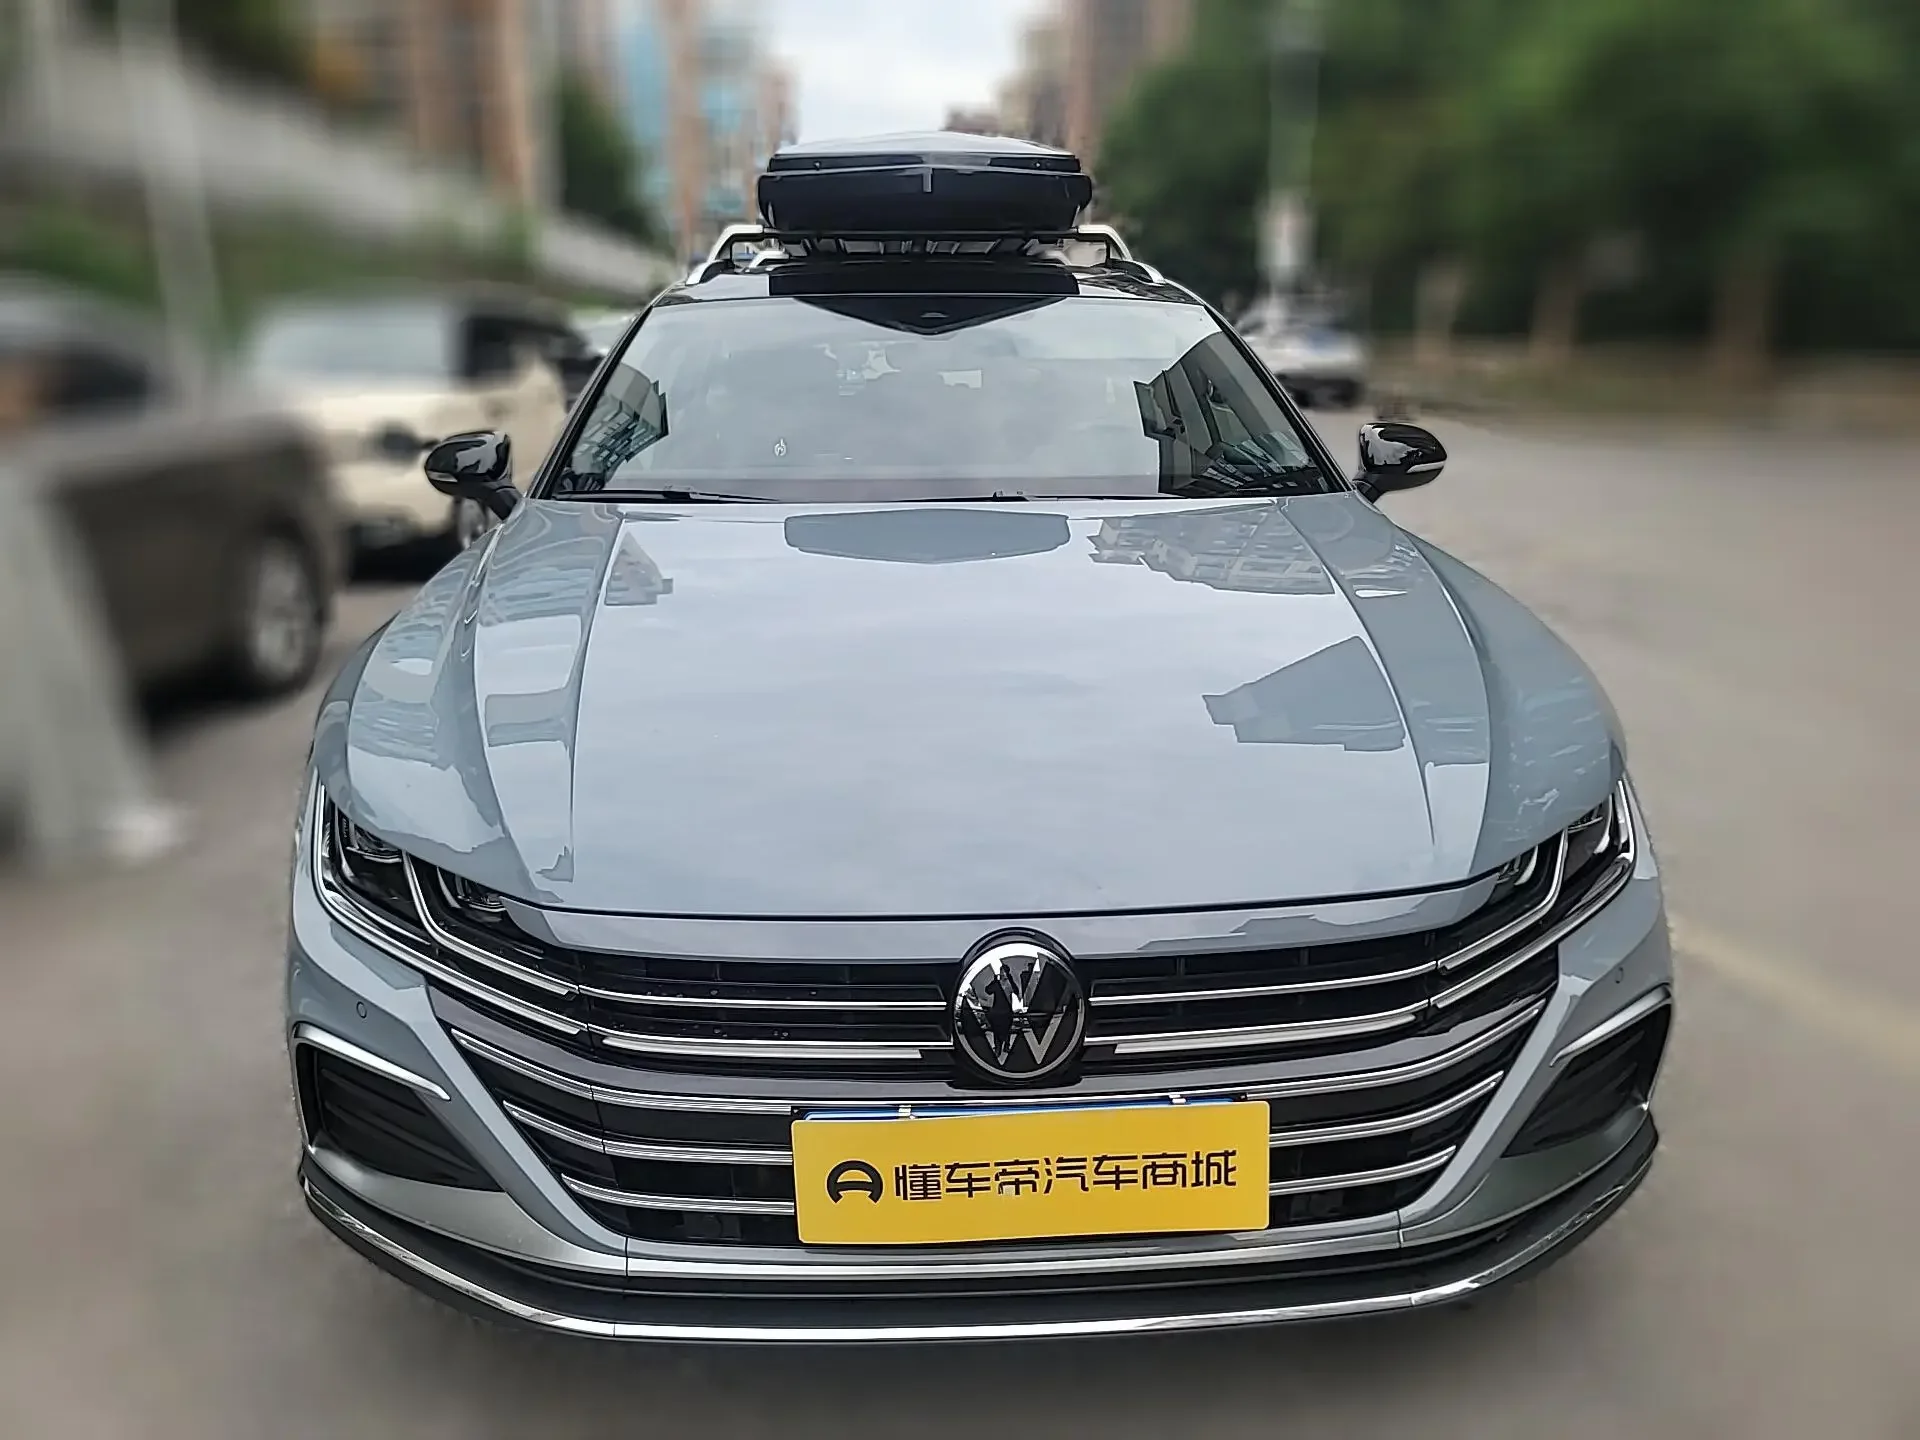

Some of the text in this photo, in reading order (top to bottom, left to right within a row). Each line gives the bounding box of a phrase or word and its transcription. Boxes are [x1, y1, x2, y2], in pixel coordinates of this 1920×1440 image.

[894, 1149, 1237, 1200] 懂车帝汽车商城
